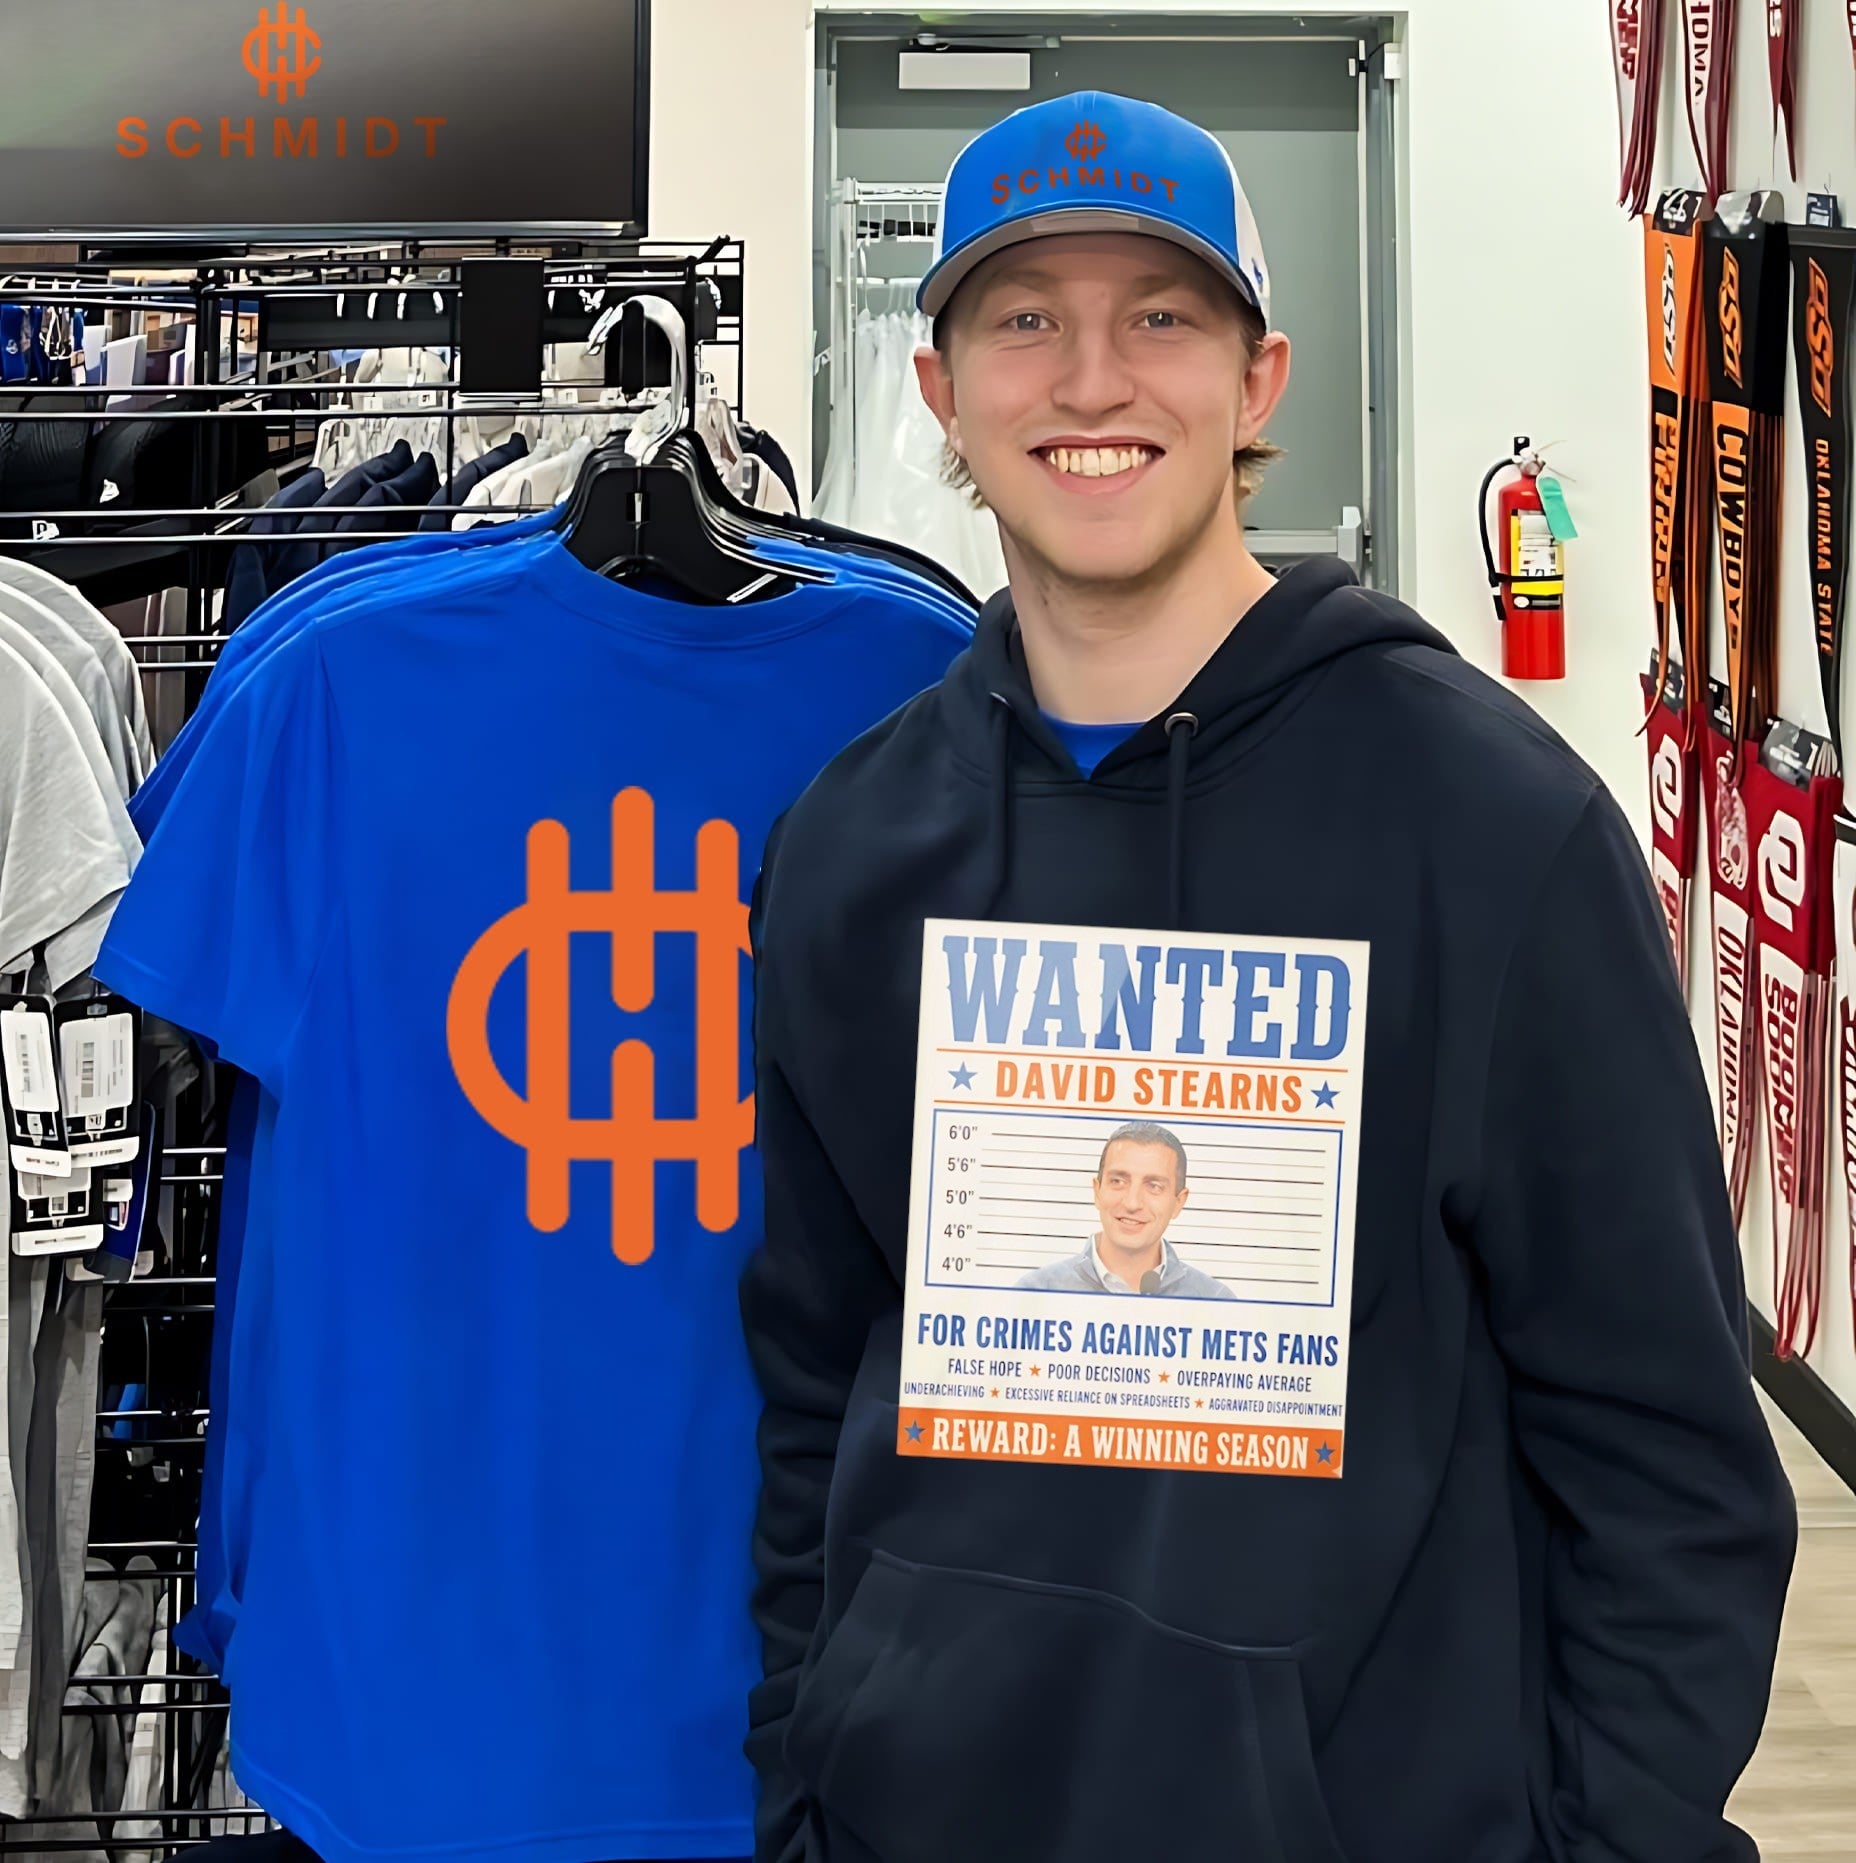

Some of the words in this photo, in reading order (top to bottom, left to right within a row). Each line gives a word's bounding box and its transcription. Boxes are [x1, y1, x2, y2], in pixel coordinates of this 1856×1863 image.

[116, 117, 447, 158] SCHMIDT
[991, 167, 1179, 205] SCHMIDT
[1815, 438, 1832, 569] OKLAHOMA
[942, 935, 1352, 1061] WANTED
[996, 1061, 1115, 1103] DAVID
[1133, 1068, 1302, 1113] STEARNS
[917, 1313, 966, 1347] FOR
[976, 1316, 1073, 1353] CRIMES
[1081, 1322, 1193, 1358] AGAINST
[1201, 1328, 1267, 1363] METS
[1277, 1333, 1339, 1367] FANS
[904, 1382, 985, 1398] UNDERACHIEVING
[1005, 1387, 1055, 1402] EXCESSIVE
[1057, 1390, 1102, 1404] RELIANCE
[1105, 1392, 1118, 1405] ON
[1120, 1393, 1191, 1409] SPREADSHEETS
[1208, 1398, 1264, 1413] AGGRAVATED
[1266, 1400, 1343, 1417] DISAPPOINTMENT
[948, 1358, 985, 1376] FALSE
[989, 1360, 1022, 1377] HOPE
[1048, 1363, 1081, 1380] POOR
[1085, 1366, 1151, 1384] DECISIONS
[1177, 1370, 1254, 1389] OVERPAYING
[1257, 1374, 1312, 1393] AVERAGE
[932, 1417, 1056, 1456] REWARD:
[1064, 1425, 1082, 1458] A
[1091, 1426, 1208, 1465] WINNING
[1215, 1432, 1309, 1471] SEASON
